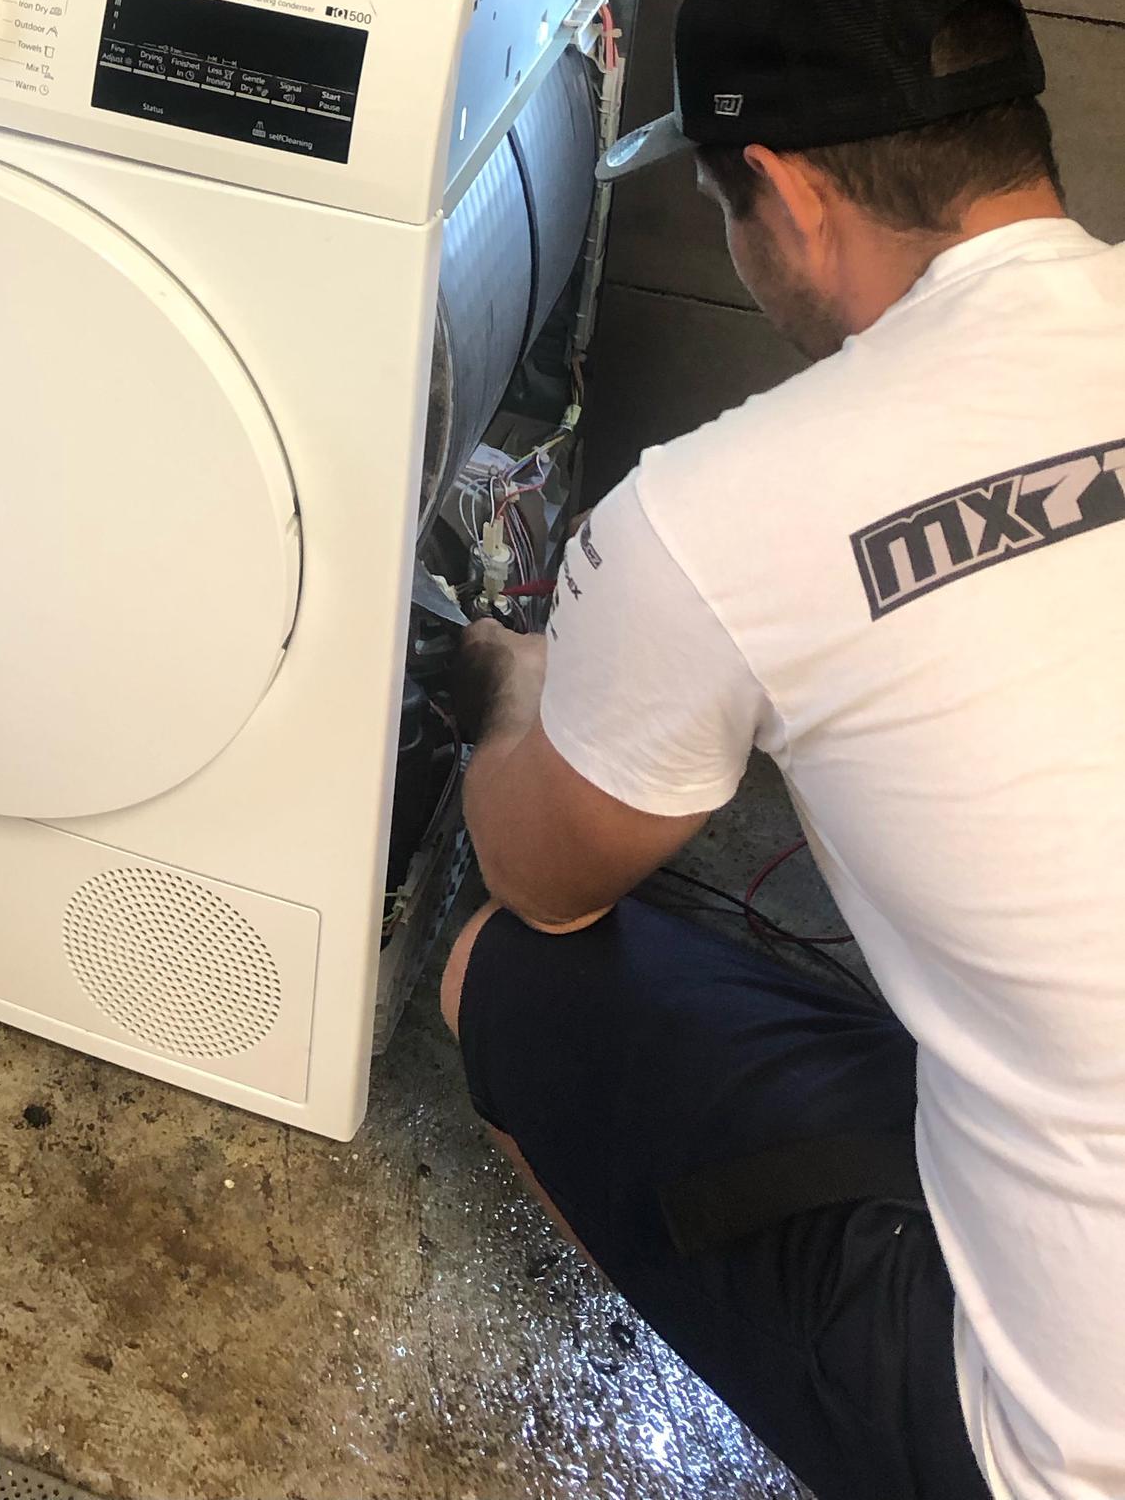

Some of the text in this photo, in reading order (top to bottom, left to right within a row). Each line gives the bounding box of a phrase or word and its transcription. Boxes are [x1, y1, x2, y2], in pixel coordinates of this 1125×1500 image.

[18, 0, 49, 15] Iron Dry
[277, 0, 315, 13] condenser
[14, 19, 46, 34] Outdoor
[18, 40, 42, 53] Towels
[101, 52, 123, 65] Adjust
[140, 50, 163, 64] Drying
[171, 56, 200, 71] Finished
[138, 60, 155, 71] Time
[207, 65, 223, 76] Less
[176, 68, 184, 77] In
[242, 73, 266, 85] Gentle
[15, 80, 37, 92] Warm
[206, 75, 231, 89] Ironing
[279, 81, 302, 94] Signal
[240, 83, 253, 95] Dry
[321, 91, 341, 102] Start
[143, 102, 164, 114] Status
[319, 101, 341, 112] Pause
[269, 131, 313, 150] selfCleaning
